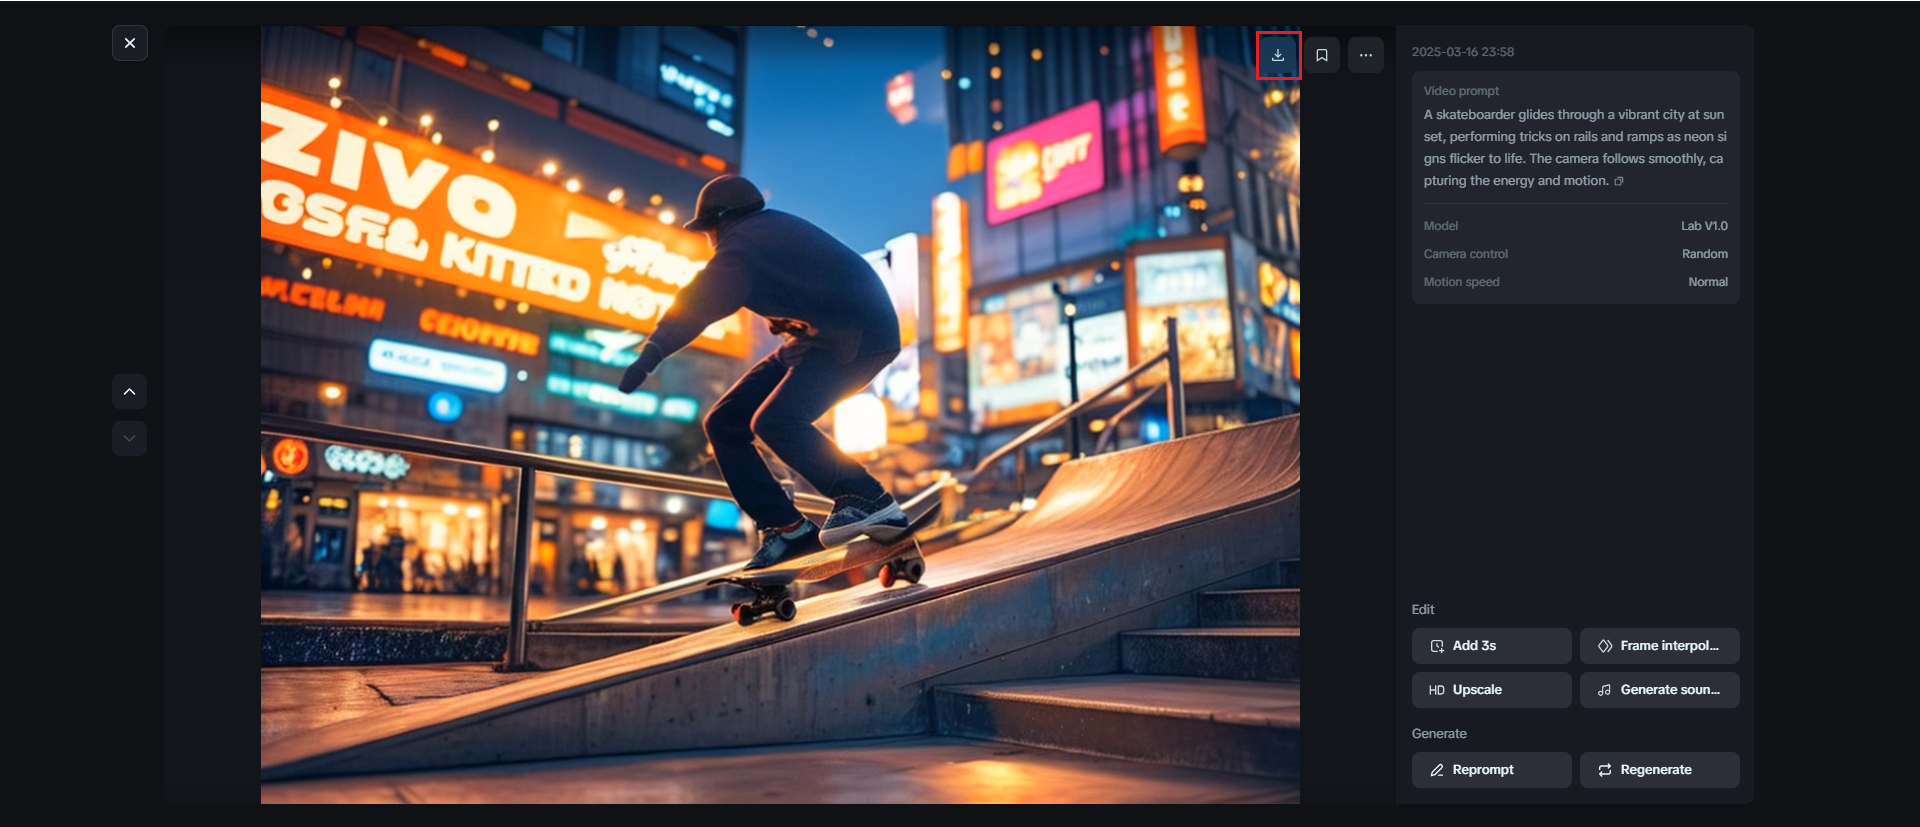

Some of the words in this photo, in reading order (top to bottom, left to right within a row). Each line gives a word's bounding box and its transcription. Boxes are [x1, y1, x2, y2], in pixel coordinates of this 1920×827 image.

[1411, 46, 1479, 58] 2025-03-16
[1481, 46, 1515, 58] 23:58
[1423, 85, 1457, 97] Video
[1458, 85, 1500, 99] prompt
[1423, 108, 1434, 120] A
[1435, 108, 1516, 121] skateboarder
[1517, 108, 1555, 123] glides
[1556, 108, 1605, 123] through
[1607, 111, 1616, 121] a
[1617, 108, 1661, 121] vibrant
[1662, 108, 1686, 123] city
[1687, 109, 1701, 121] at
[1702, 111, 1725, 121] sun
[1423, 131, 1447, 145] set,
[1449, 130, 1517, 145] performing
[1518, 130, 1553, 143] tricks
[1554, 133, 1571, 143] on
[1573, 130, 1599, 143] rails
[1600, 130, 1624, 143] and
[1626, 133, 1665, 145] ramps
[1666, 133, 1682, 143] as
[1683, 133, 1715, 143] neon
[1716, 130, 1728, 143] si
[1423, 155, 1447, 167] gns
[1448, 152, 1486, 165] flicker
[1487, 153, 1502, 165] to
[1504, 152, 1527, 165] life.
[1528, 152, 1553, 165] The
[1554, 155, 1600, 165] camera
[1601, 152, 1646, 165] follows
[1647, 152, 1707, 167] smoothly,
[1708, 155, 1724, 165] ca
[261, 101, 517, 239] ZIVO
[1423, 174, 1467, 189] pturing
[1469, 174, 1491, 187] the
[1492, 177, 1536, 189] energy
[1537, 174, 1561, 187] and
[1563, 174, 1610, 187] motion.
[1424, 220, 1459, 231] Model
[1681, 220, 1703, 232] Lab
[1704, 220, 1729, 232] V1.0
[1423, 248, 1467, 259] Camera
[1469, 248, 1509, 259] control
[1682, 248, 1729, 260] Random
[1424, 276, 1463, 287] Motion
[1465, 276, 1500, 290] speed
[1688, 276, 1729, 288] Normal
[1411, 603, 1436, 616] Edit
[1452, 639, 1479, 652] Add
[1480, 639, 1497, 652] 3s
[1620, 639, 1660, 652] Frame
[1428, 684, 1446, 696] HD
[1452, 683, 1503, 698] Upscale
[1620, 683, 1679, 696] Generate
[1411, 727, 1468, 740] Generate
[1452, 763, 1515, 778] Reprompt
[1620, 763, 1693, 778] Regenerate
